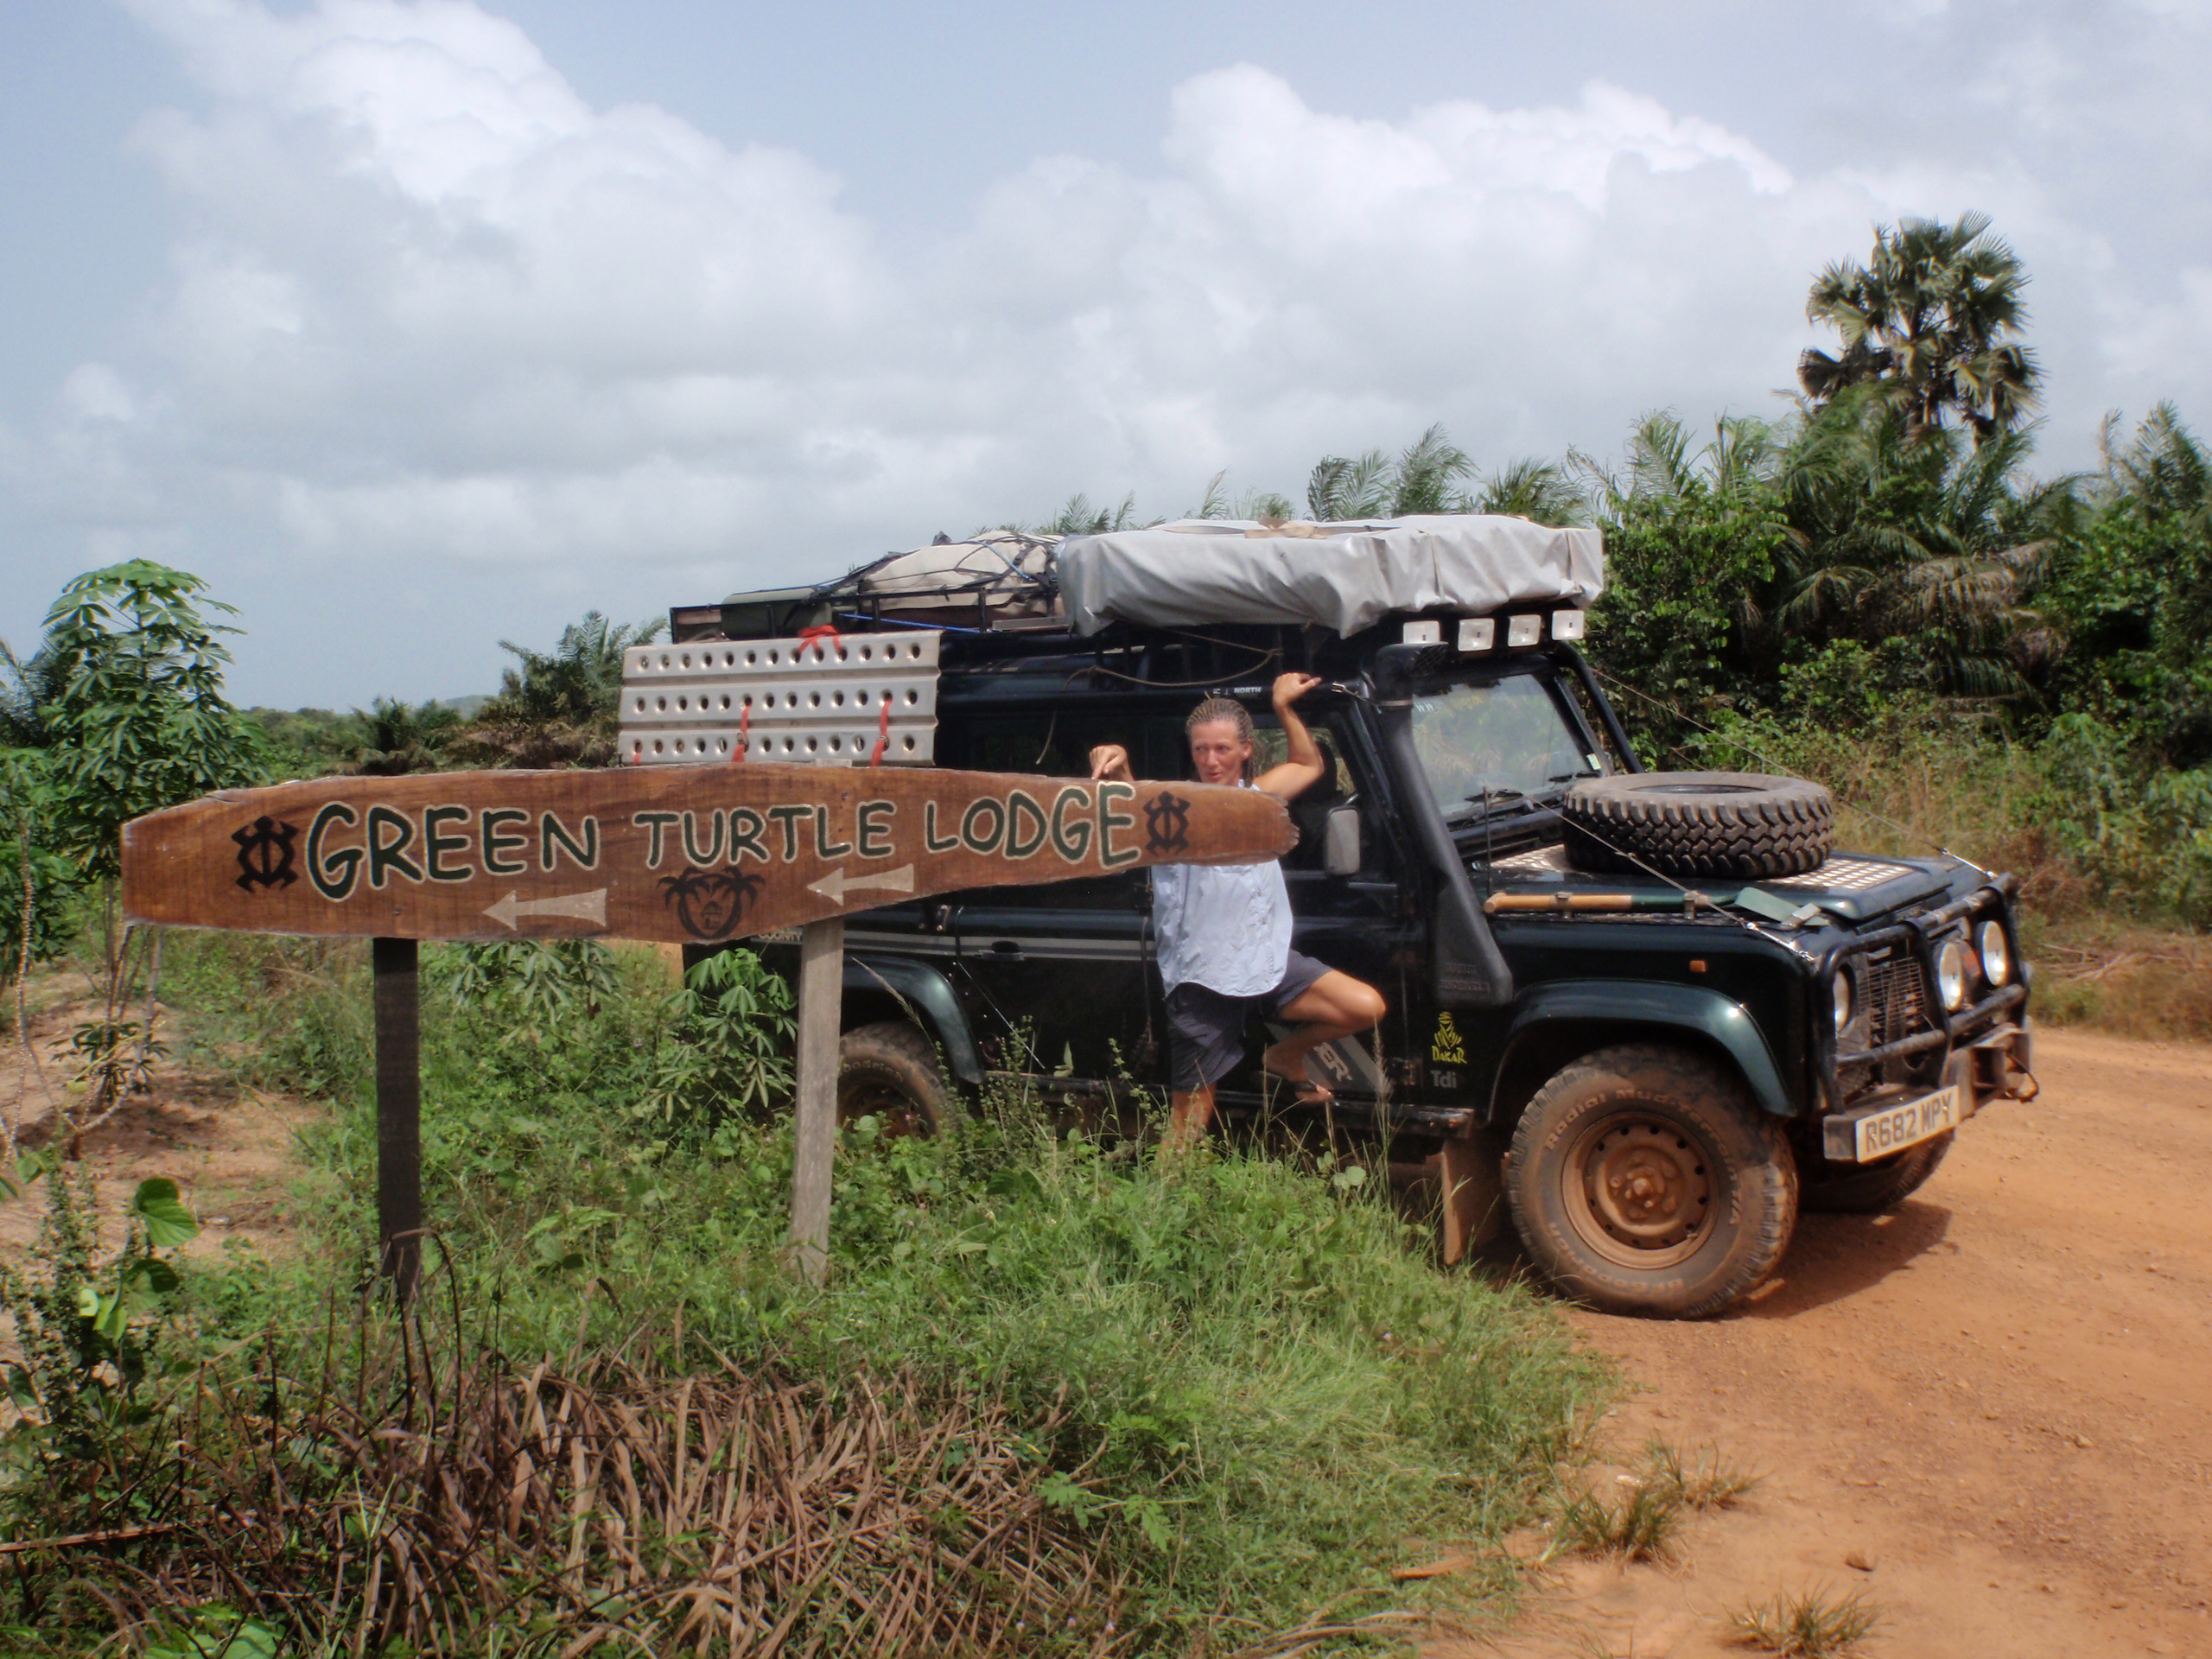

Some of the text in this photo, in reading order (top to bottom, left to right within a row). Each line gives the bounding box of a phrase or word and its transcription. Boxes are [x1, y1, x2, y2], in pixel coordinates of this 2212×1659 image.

[306, 781, 1142, 903] GREEN TURTLE LODGE
[1430, 1069, 1458, 1089] Tdi
[1431, 1046, 1467, 1064] DAKAR
[1545, 1093, 1607, 1151] Radial
[1865, 1092, 1952, 1153] R682 MPY
